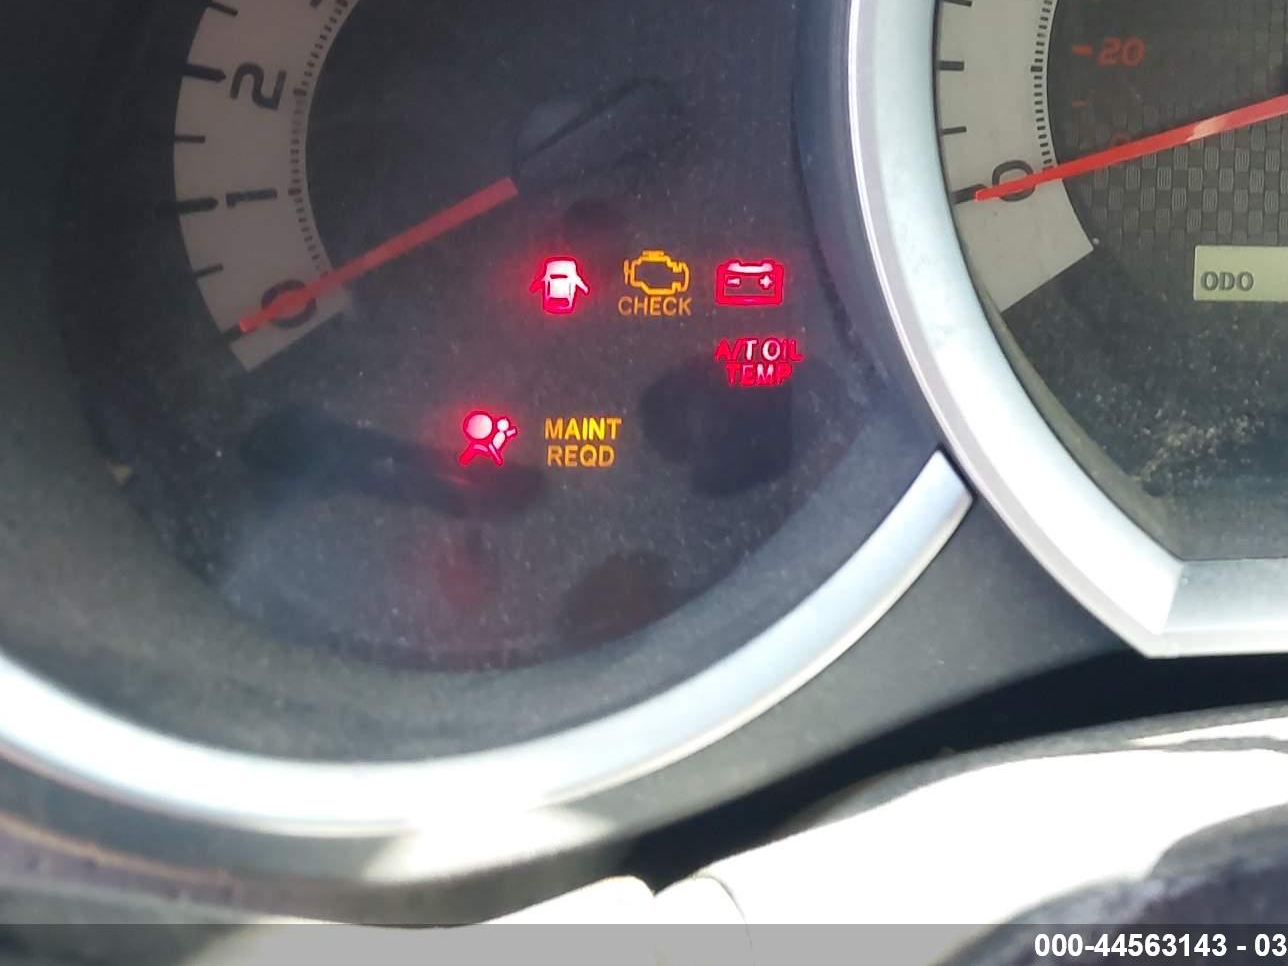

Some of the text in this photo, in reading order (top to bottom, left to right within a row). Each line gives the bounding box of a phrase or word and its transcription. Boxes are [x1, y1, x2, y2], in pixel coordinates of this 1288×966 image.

[1098, 37, 1145, 66] 20
[230, 61, 287, 111] 2
[992, 159, 1037, 202] 0
[225, 187, 279, 209] 1
[1200, 270, 1255, 292] ODO
[261, 279, 316, 328] 0
[617, 296, 692, 318] CHECK
[762, 337, 804, 363] OIL
[725, 362, 793, 387] TEMP
[543, 417, 622, 441] MAINT
[546, 444, 616, 468] REQD
